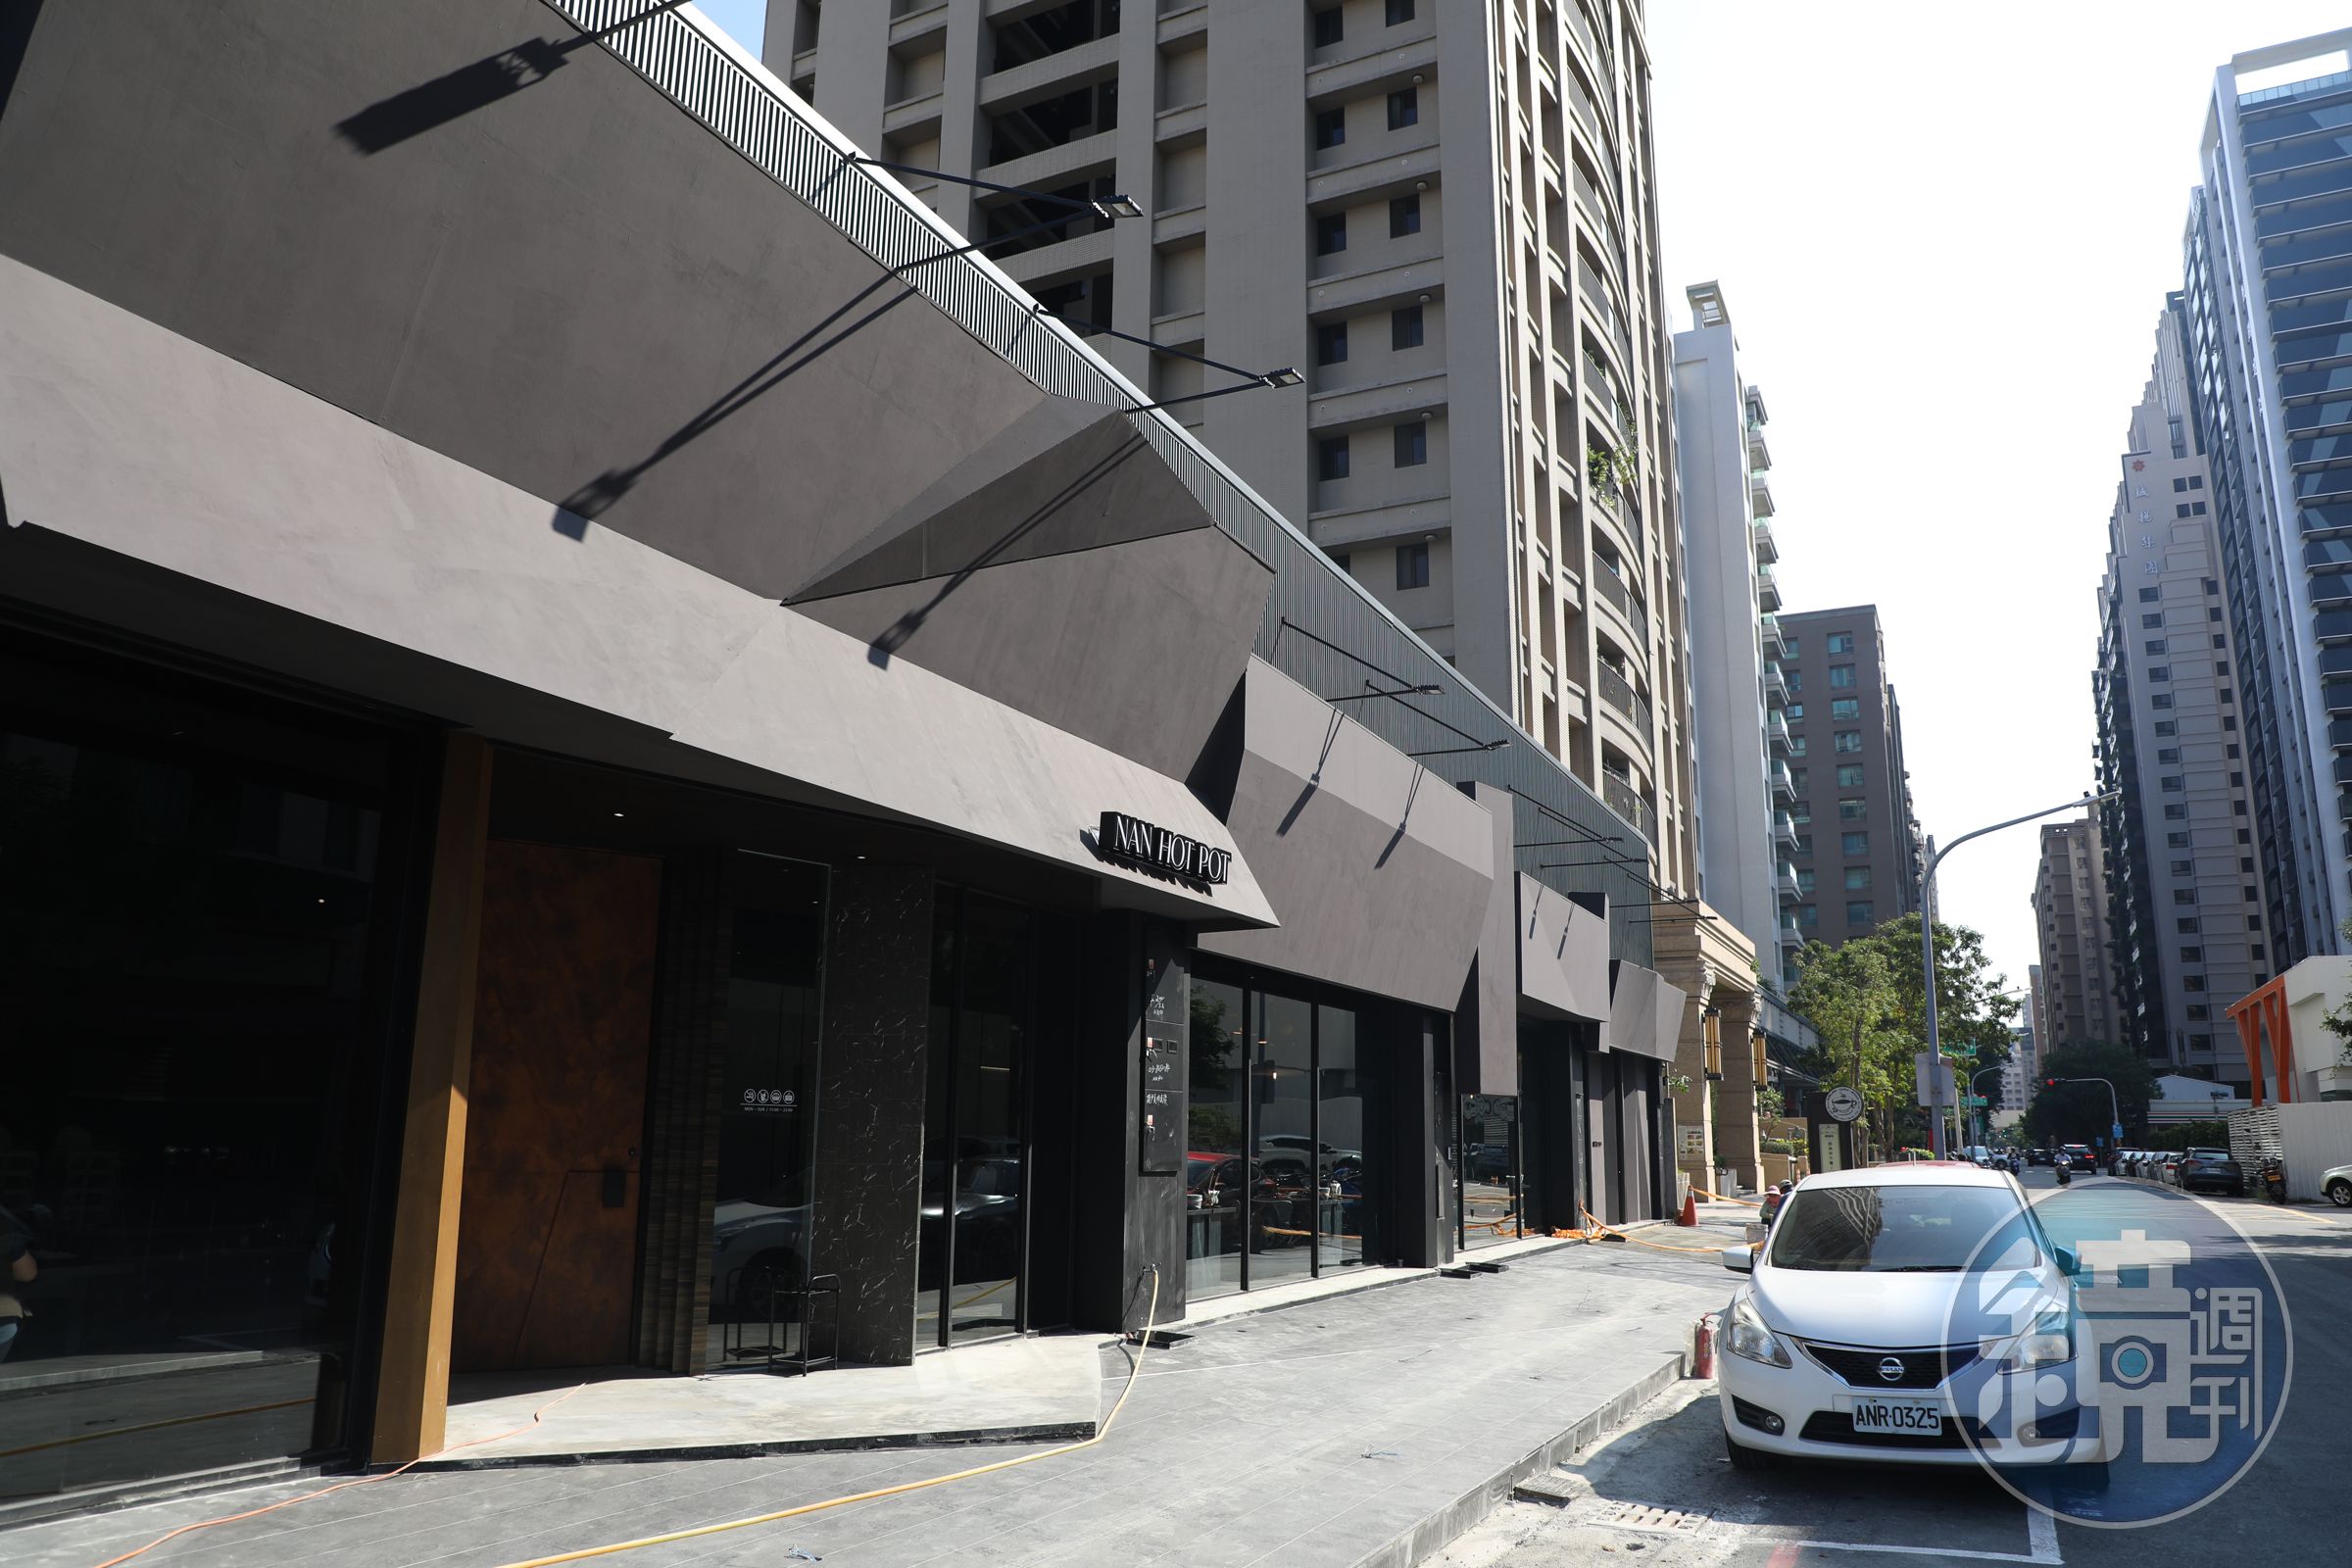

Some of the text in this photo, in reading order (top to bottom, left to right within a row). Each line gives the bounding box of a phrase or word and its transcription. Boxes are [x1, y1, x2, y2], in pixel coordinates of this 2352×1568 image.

[1114, 815, 1231, 883] NAN HOT POT
